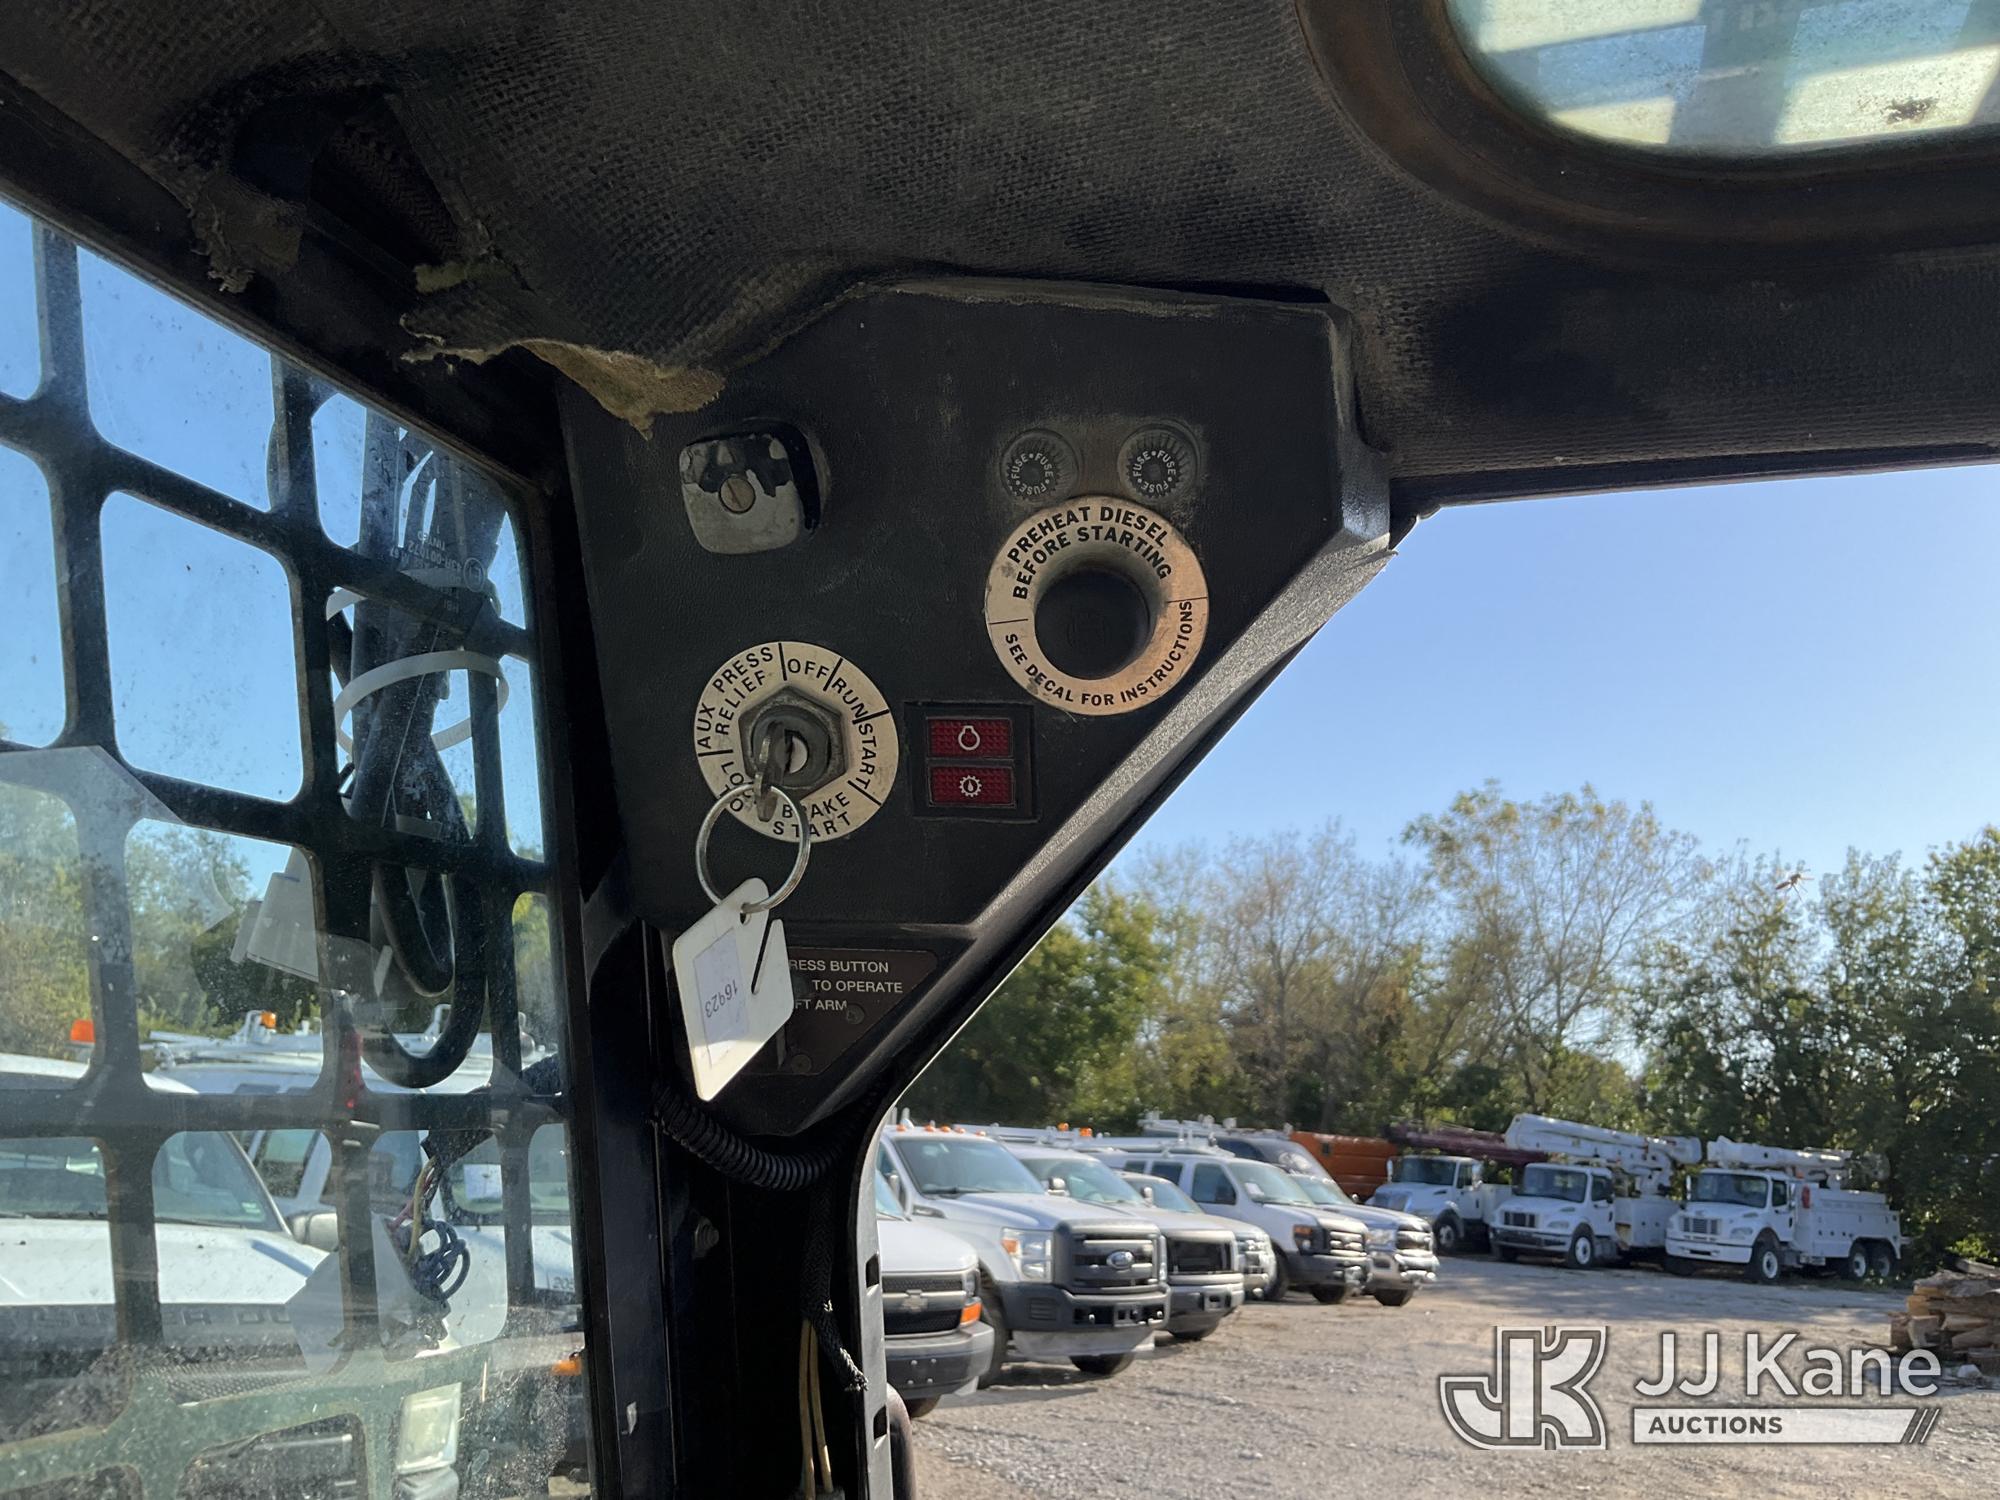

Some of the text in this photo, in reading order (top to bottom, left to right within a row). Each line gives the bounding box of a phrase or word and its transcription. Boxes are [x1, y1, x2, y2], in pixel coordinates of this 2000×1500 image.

[1011, 453, 1029, 479] FUSE
[1035, 452, 1054, 476] FUSE
[1132, 450, 1151, 478] FUSE
[1157, 450, 1177, 475] FUSE
[1019, 483, 1047, 496] FUSE
[1140, 479, 1170, 494] FUSE
[1007, 506, 1169, 564] PREHEAT DIESEL
[1013, 526, 1173, 600] BEFORE STARTING
[1005, 600, 1193, 706] SEE DECAL FOR INSTRUCTIONS
[787, 658, 829, 679] OFF
[697, 647, 773, 750] AUX PRESS
[715, 670, 766, 735] RELIEF
[833, 678, 869, 720] RUN
[858, 722, 877, 789] START
[782, 792, 850, 818] BAKE
[789, 959, 889, 973] RESS BUTTON
[704, 979, 738, 1018] 16923
[812, 980, 903, 993] TO OPERATE
[794, 1000, 848, 1011] FT ARM
